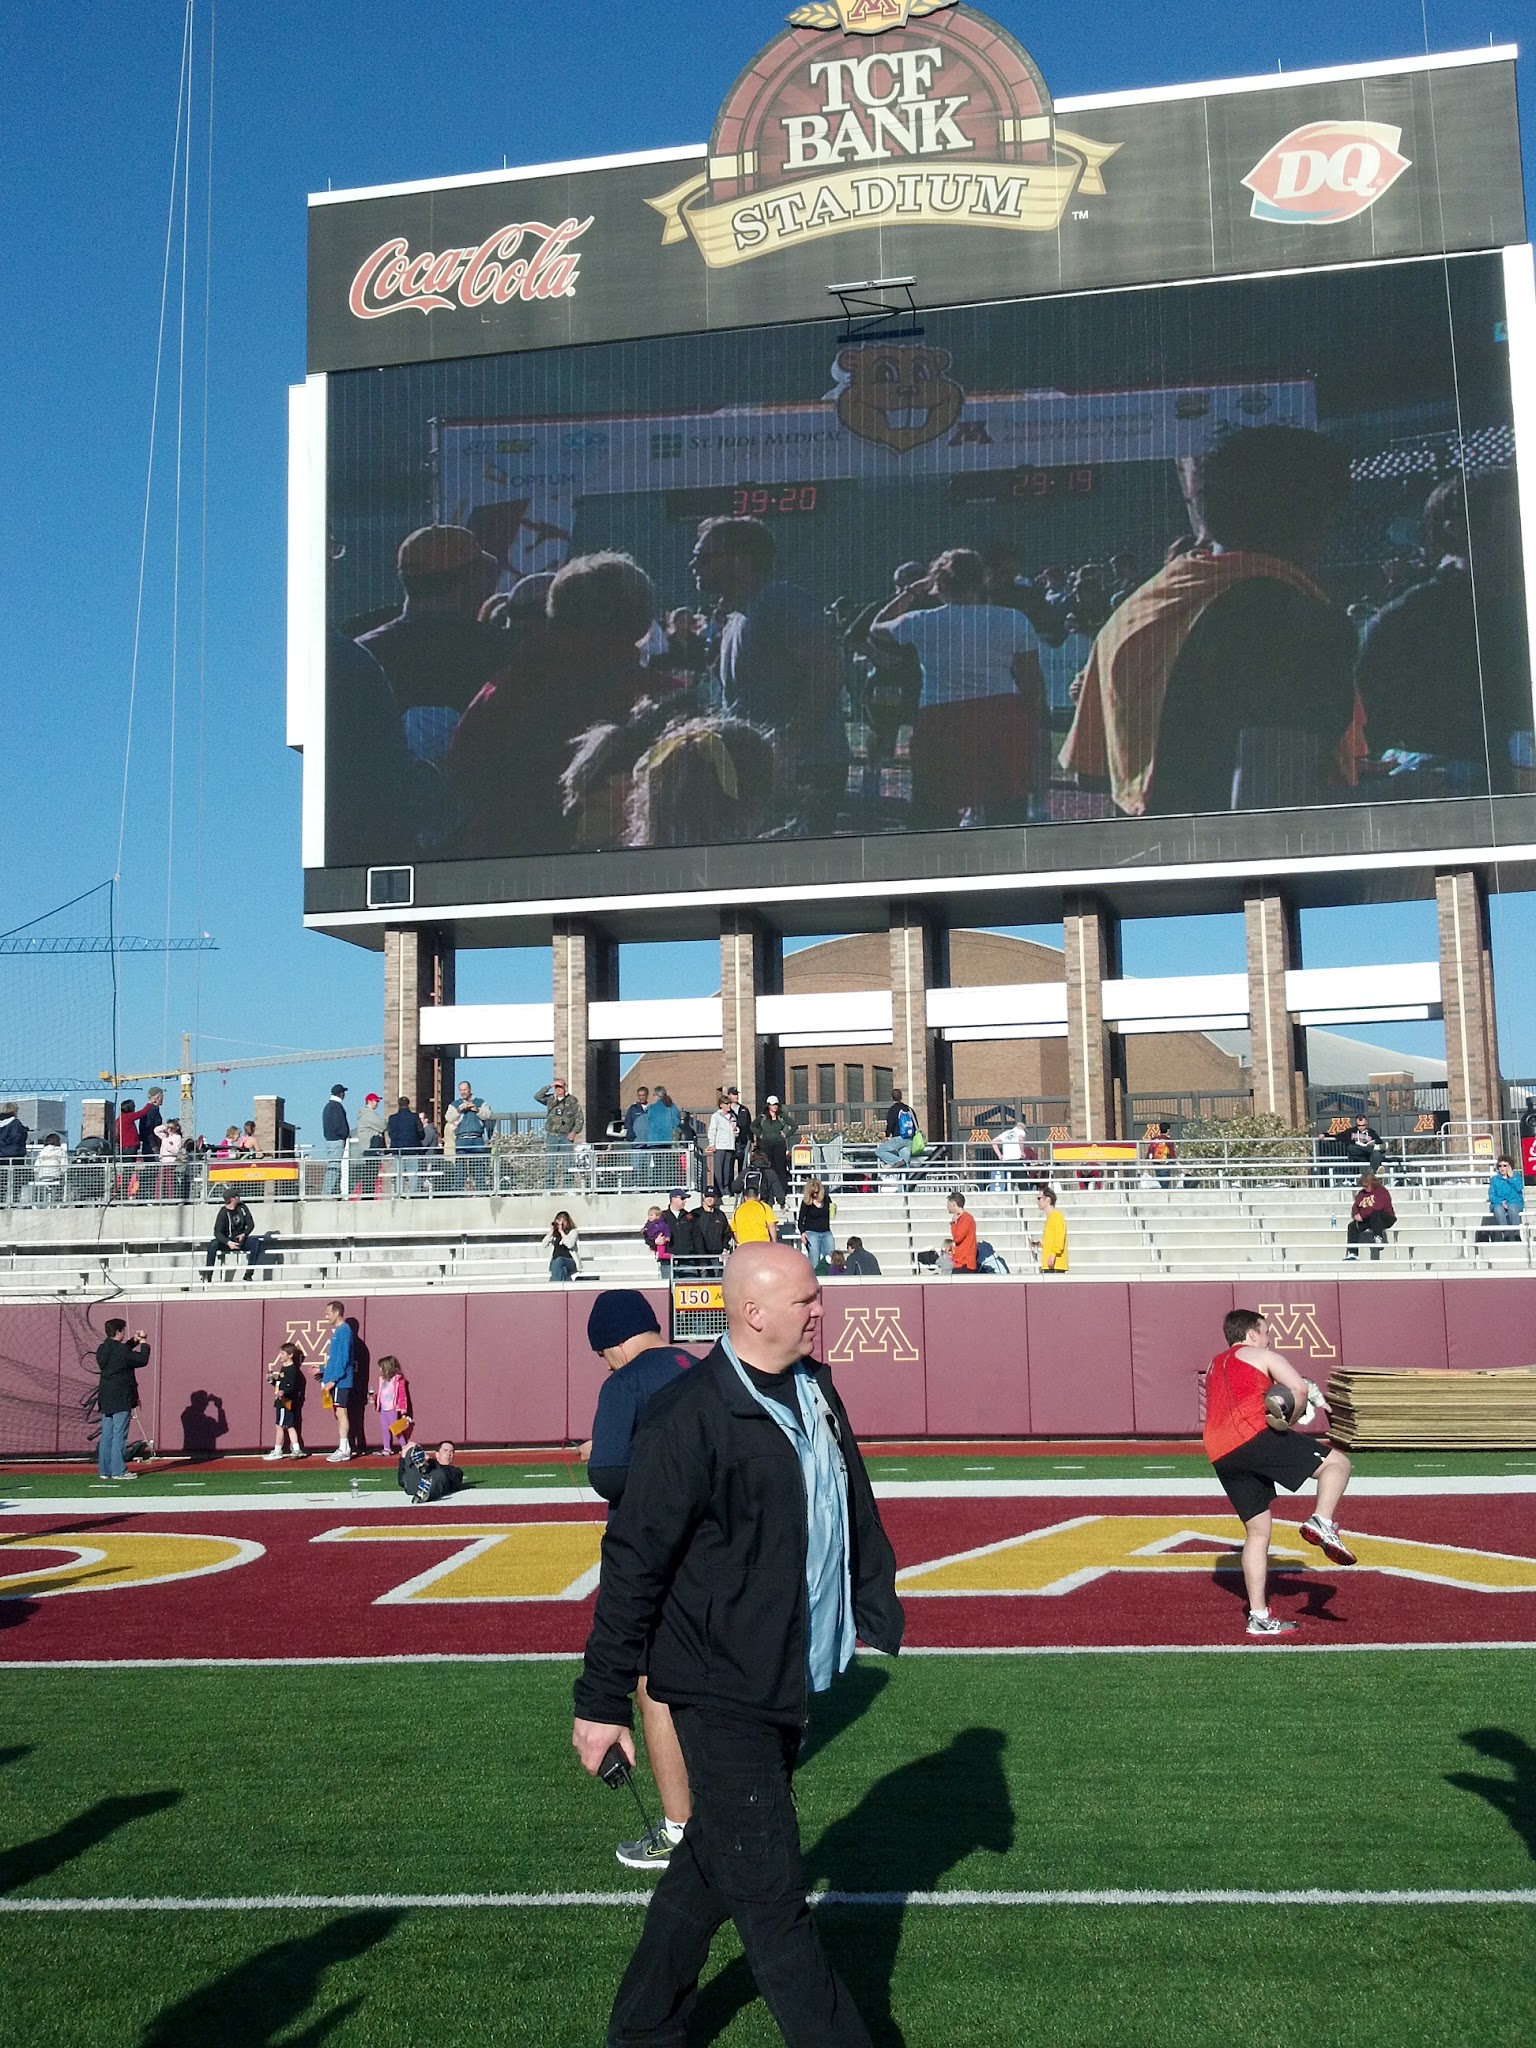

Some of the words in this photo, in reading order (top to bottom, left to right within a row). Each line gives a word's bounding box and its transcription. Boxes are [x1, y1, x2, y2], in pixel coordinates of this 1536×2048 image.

[810, 46, 941, 112] TCF
[781, 96, 974, 171] BANK
[1273, 143, 1380, 201] DQ
[731, 174, 1027, 249] STADIUM
[349, 215, 594, 319] Coca-Cola
[679, 1289, 710, 1305] 150
[828, 1306, 919, 1362] M
